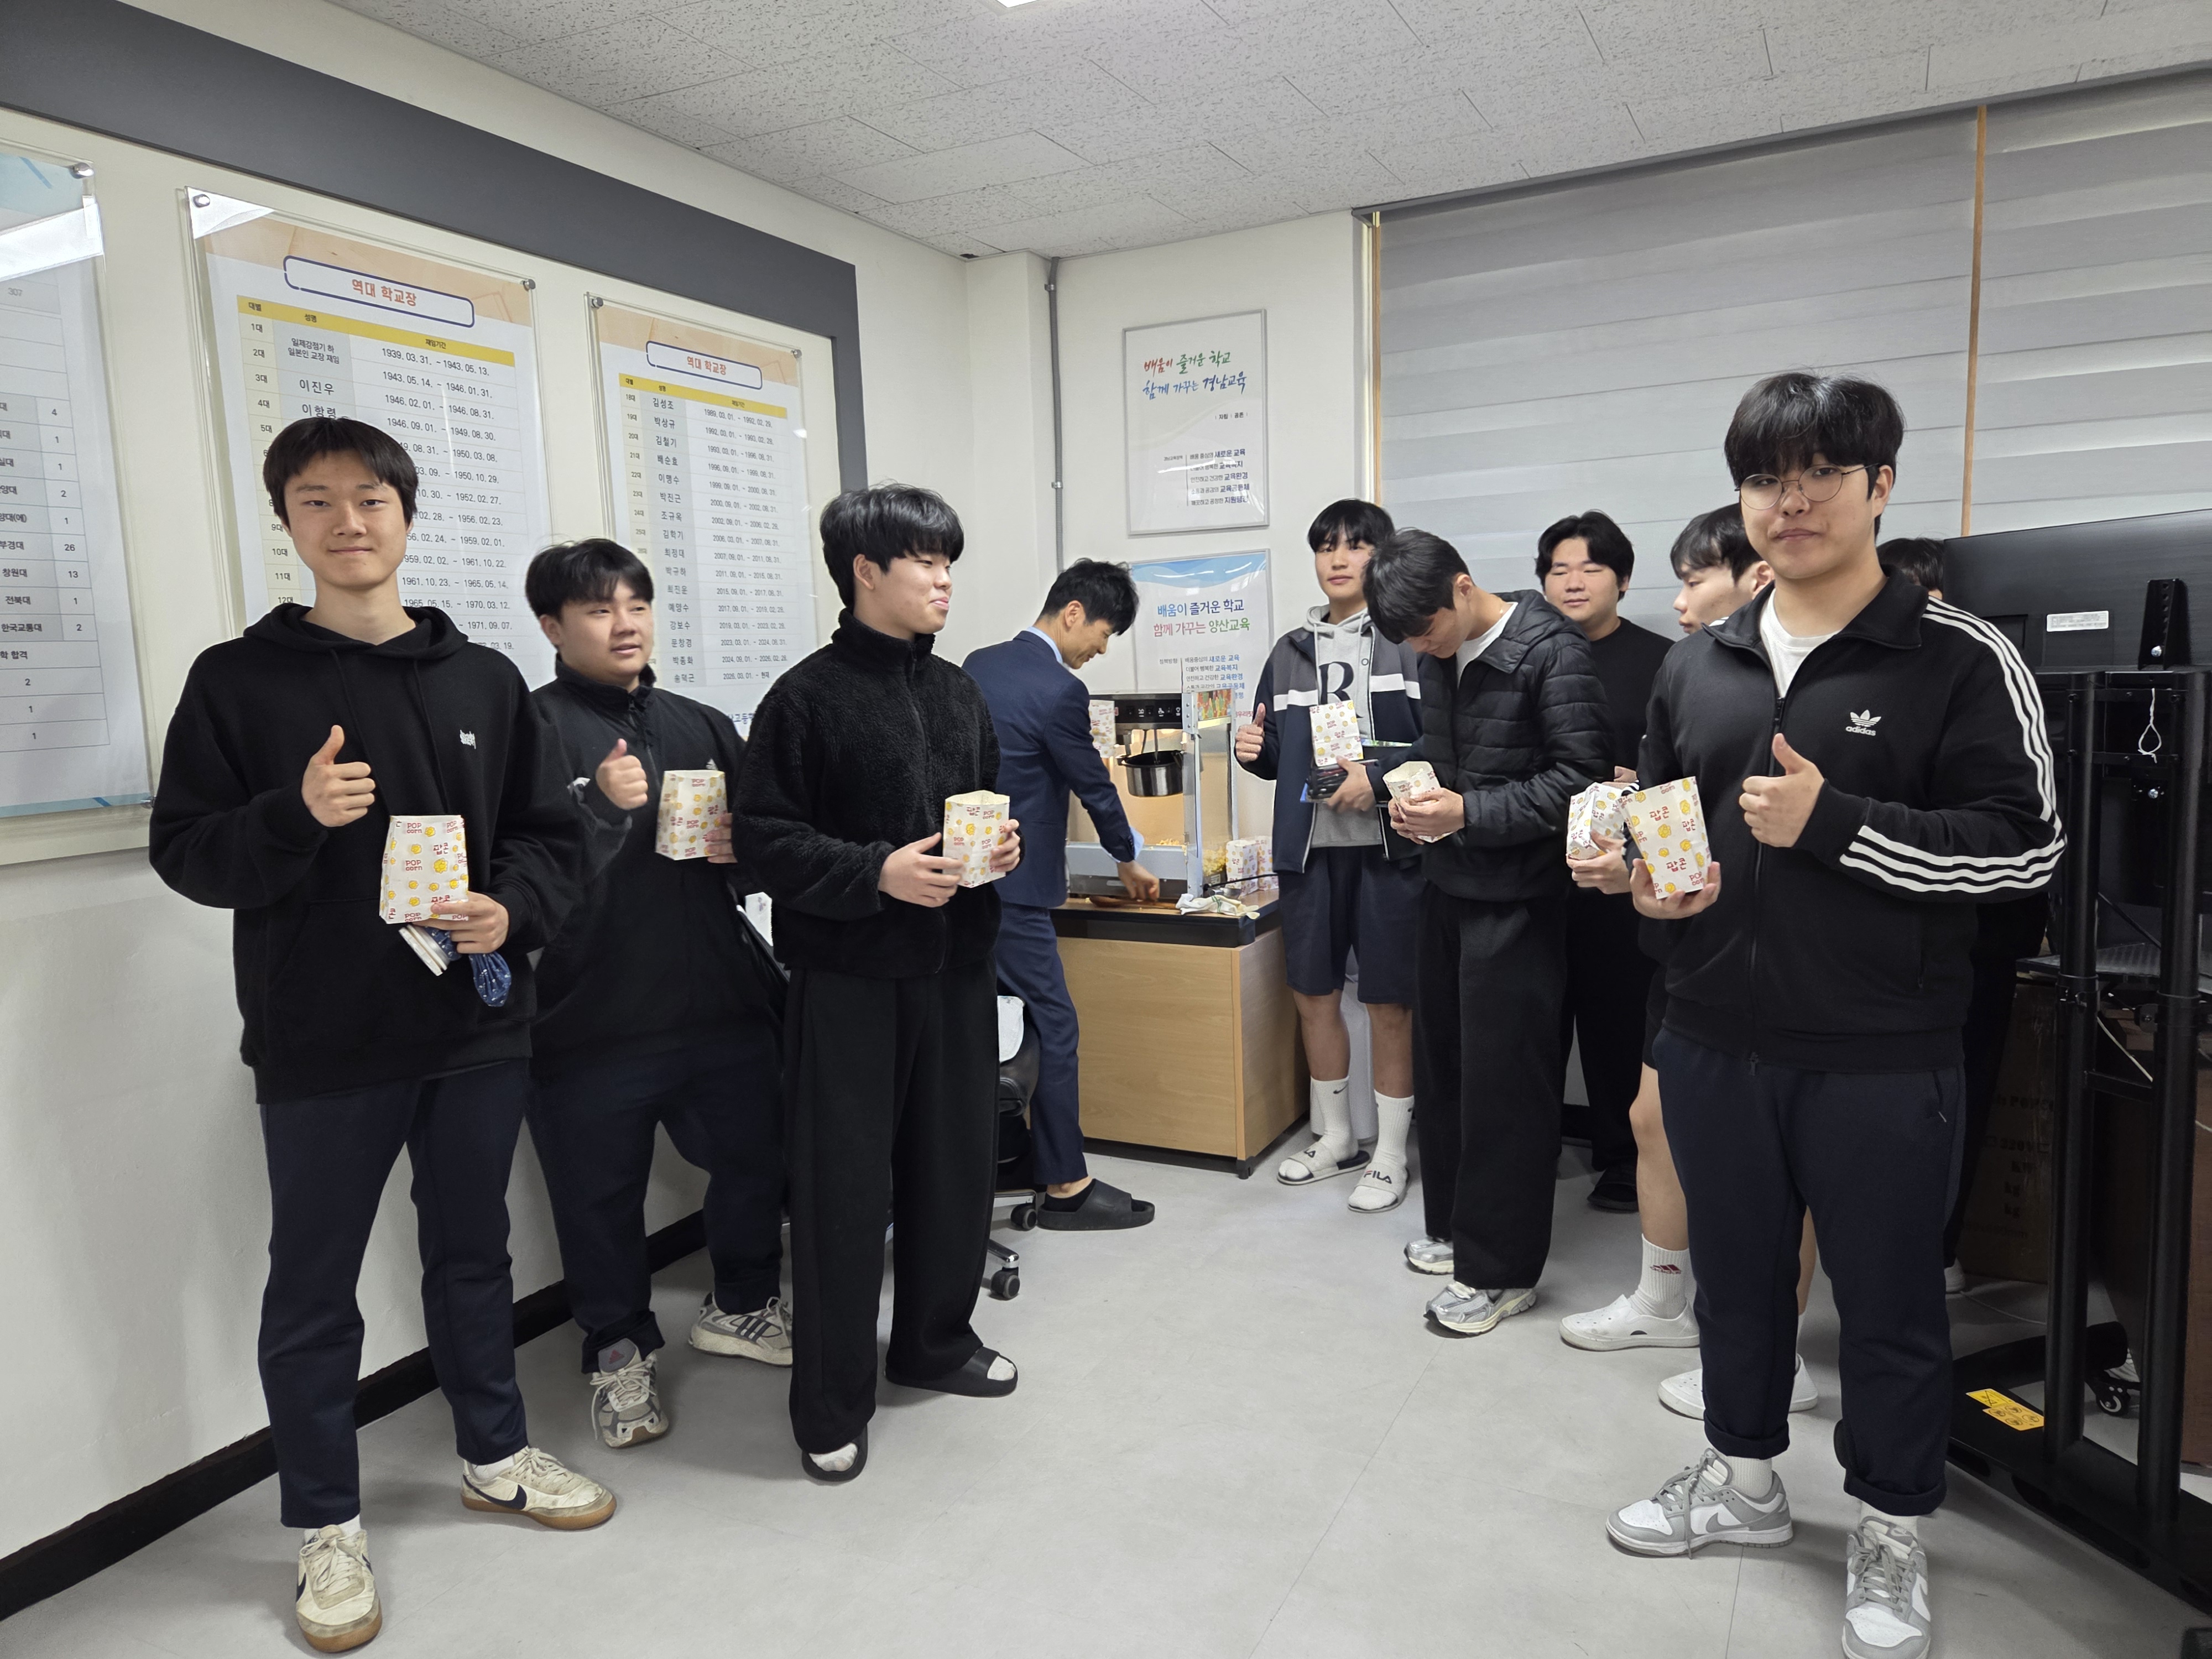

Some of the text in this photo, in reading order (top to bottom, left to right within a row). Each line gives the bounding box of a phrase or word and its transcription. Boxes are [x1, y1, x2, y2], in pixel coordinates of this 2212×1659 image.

[8, 288, 23, 297] 307
[352, 279, 416, 307] 역대 학교장
[305, 314, 317, 323] 성명
[251, 324, 263, 333] 1대
[291, 338, 334, 353] 일제강점기 하
[253, 349, 265, 358] 2대
[288, 347, 339, 364] 일본인 교장 재임
[687, 356, 727, 375] 역대 학교장
[1144, 350, 1231, 377] 배움이 즐거운 학교
[255, 374, 334, 395] 3대 이진우
[1142, 371, 1247, 400] 함께 가꾸는 경남교육
[258, 399, 270, 408] 4대
[653, 398, 674, 409] 김성조
[654, 416, 675, 429] 박상규
[260, 425, 272, 434] 5대
[1215, 450, 1232, 458] 새로운
[1234, 448, 1245, 457] 교육
[1224, 472, 1248, 481] 교육환경
[660, 492, 680, 503] 박진근
[271, 524, 283, 532] 9대
[272, 548, 288, 557] 10대
[2, 568, 28, 577] 창원대
[275, 572, 290, 581] 11대
[5, 596, 31, 605] 전북대
[1157, 599, 1244, 618] 배움이 즐거운 학교
[1, 623, 43, 632] 한국교통대
[1154, 618, 1250, 637] 함께 가꾸는 양산교육
[11, 651, 28, 660] 합격
[1319, 661, 1364, 719] R
[1845, 726, 1876, 736] adidas
[1649, 806, 1670, 821] 팝콘
[1682, 818, 1696, 832] 팝콘
[434, 842, 448, 855] 팝콘
[1666, 858, 1687, 872] 팝콘
[1364, 1170, 1392, 1184] FILA
